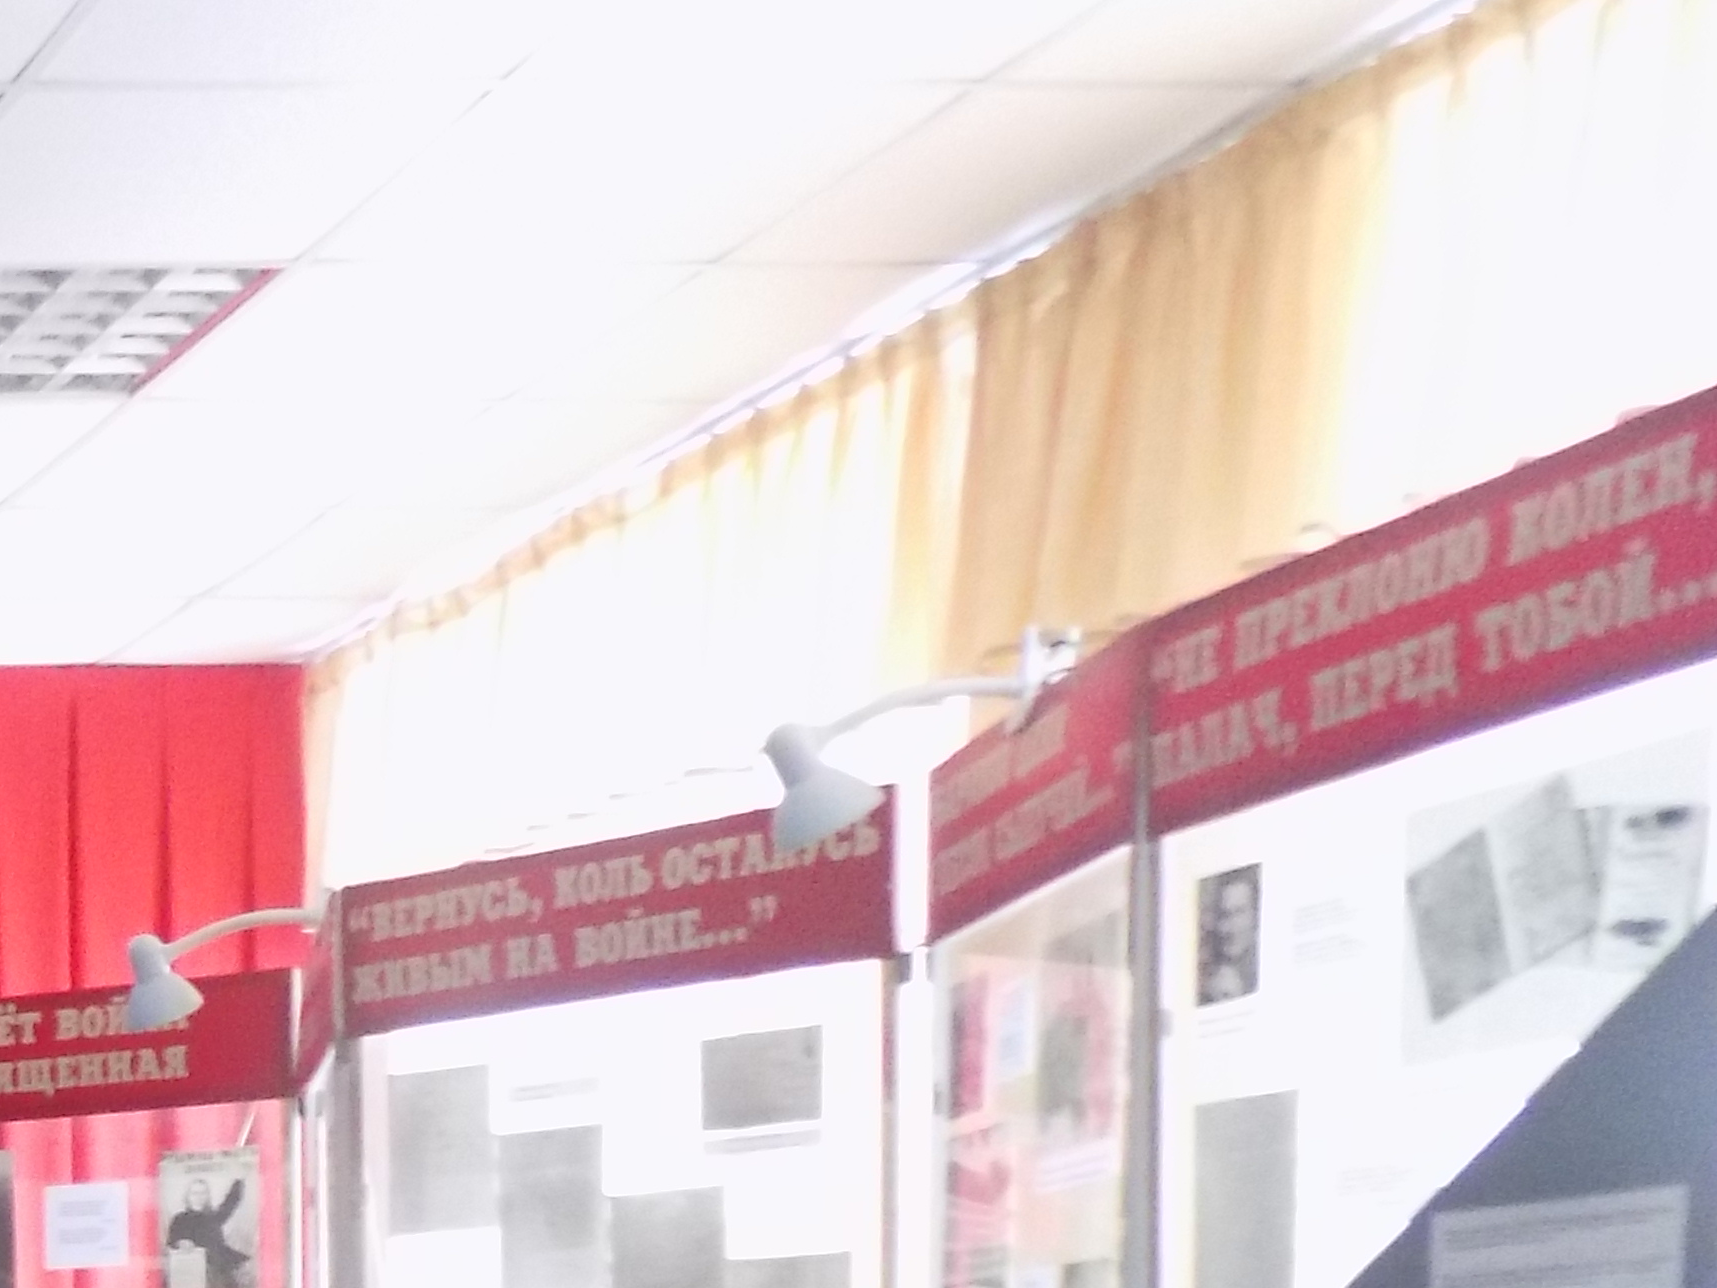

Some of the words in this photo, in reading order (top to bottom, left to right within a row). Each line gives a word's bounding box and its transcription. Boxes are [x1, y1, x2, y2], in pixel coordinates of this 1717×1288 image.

[1232, 517, 1489, 672] ПРЕКЛОНЮ
[1506, 432, 1716, 568] КОЛЕН,
[1150, 686, 1297, 788] ПАЛАЧ,
[1310, 620, 1458, 732] ПЕРЕД
[349, 876, 544, 943] “ВЕРНУСЬ,
[552, 854, 654, 910] КОЛЬ
[661, 820, 881, 891] ОСТАСЬ
[55, 996, 190, 1040] ВОЙ
[352, 943, 495, 1004] ЖИВЫМ
[507, 932, 557, 980] НА
